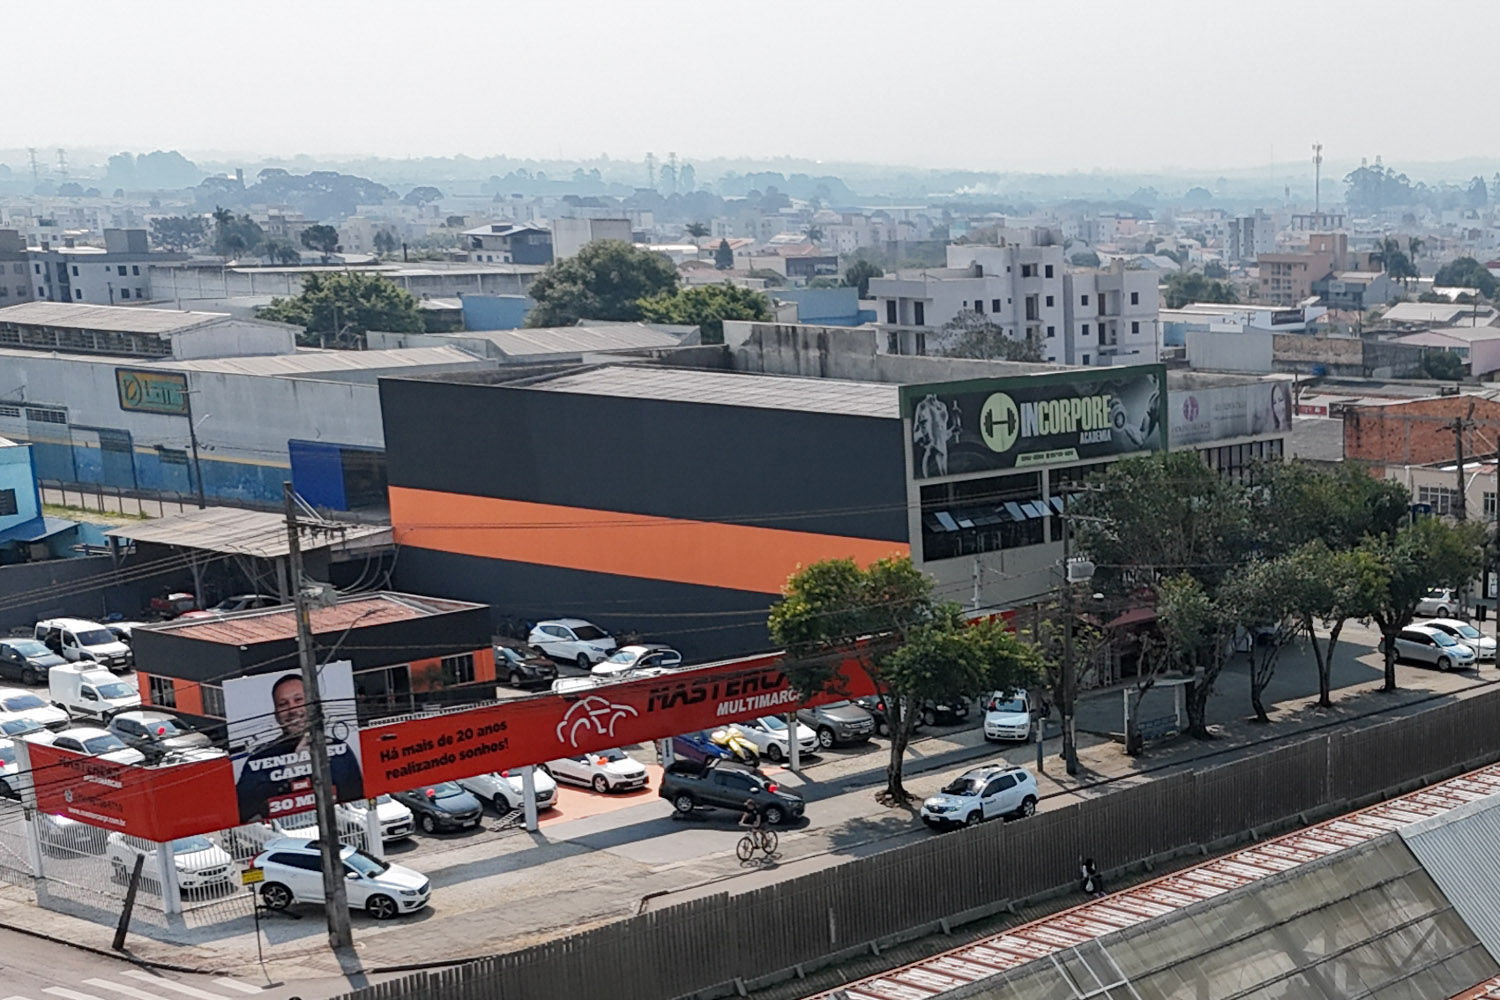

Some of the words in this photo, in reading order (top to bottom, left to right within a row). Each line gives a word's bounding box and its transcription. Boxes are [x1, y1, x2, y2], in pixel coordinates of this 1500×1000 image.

[1020, 394, 1113, 438] INCORPORE
[1080, 428, 1112, 445] ACADEMIA
[379, 747, 399, 763] Há
[402, 738, 434, 757] mais
[437, 734, 454, 749] de
[456, 727, 474, 743] 20
[477, 720, 507, 737] anos
[248, 750, 312, 772] VENDA
[386, 752, 456, 780] realizando
[459, 737, 509, 761] sonhos!
[269, 797, 294, 813] 30
